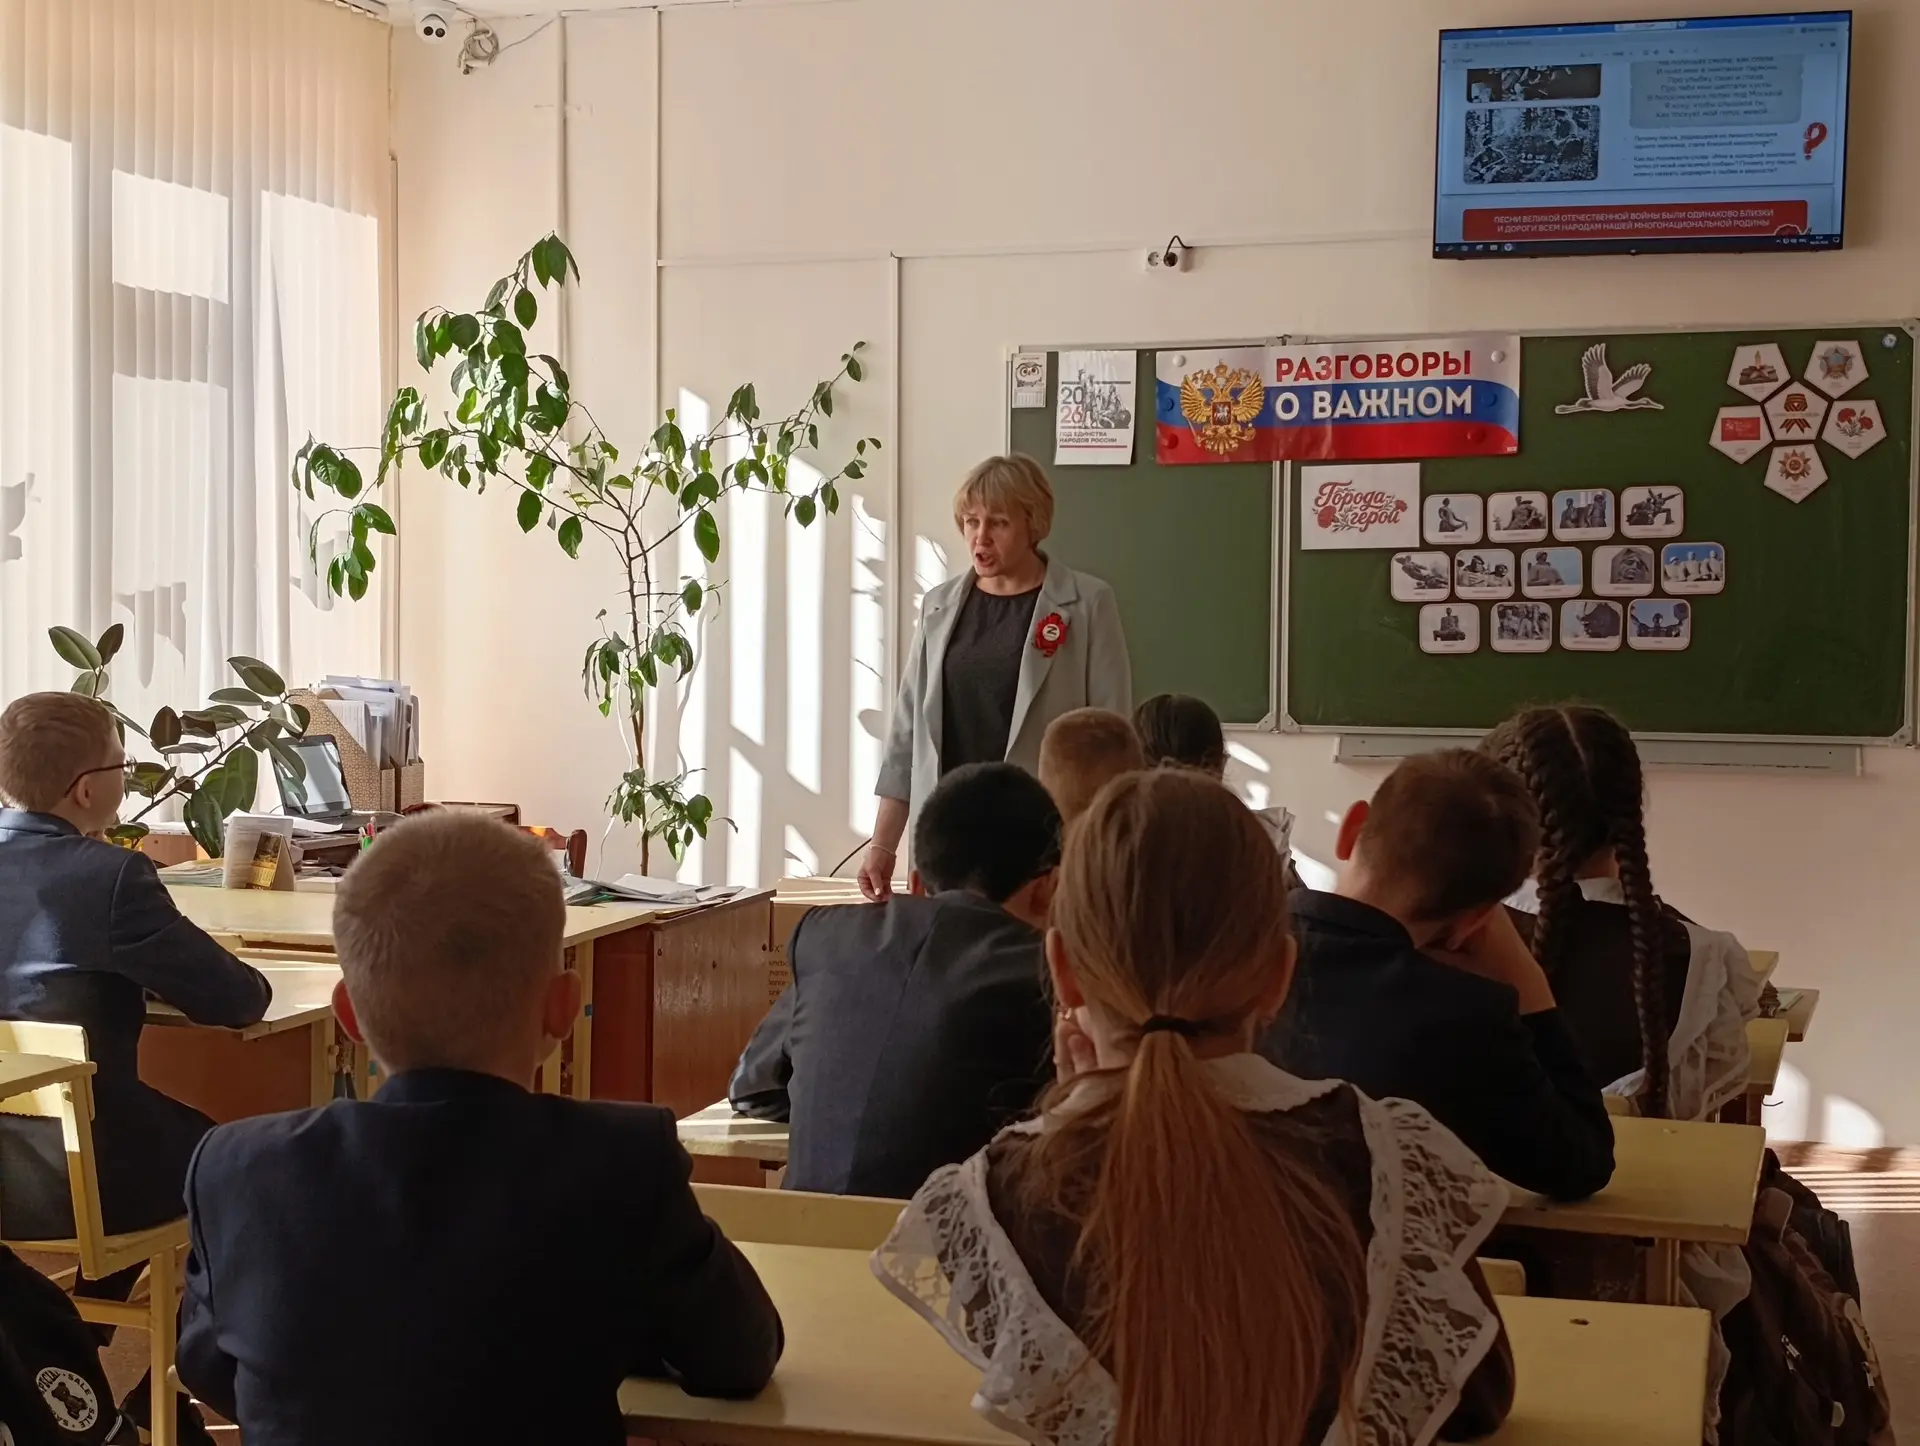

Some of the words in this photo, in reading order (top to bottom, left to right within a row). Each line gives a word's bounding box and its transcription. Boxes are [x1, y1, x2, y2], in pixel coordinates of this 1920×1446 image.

[1494, 216, 1521, 224] ПЕСНИ
[1523, 214, 1560, 223] ВЕЛИКОЙ
[1561, 212, 1629, 222] ОТЕЧЕСТВЕННОЙ
[1630, 212, 1660, 220] ВОЙНЫ
[1687, 210, 1739, 219] ОДИНАКОВО
[1740, 209, 1774, 217] БЛИЗКИ
[1505, 225, 1538, 234] ДОРОГИ
[1538, 224, 1560, 232] ВСЕМ
[1562, 224, 1602, 232] НАРОДАМ
[1603, 222, 1633, 230] НАШЕЙ
[1634, 219, 1732, 229] МНОГОНАЦИОНАЛЬНОЙ
[1733, 219, 1770, 227] РОДИНЫ
[1275, 349, 1472, 383] РАЗГОВОРЫ
[1061, 386, 1084, 405] 20
[1275, 391, 1299, 421] О
[1312, 385, 1473, 421] ВАЖНОМ
[1060, 406, 1084, 424] 26
[68, 1374, 92, 1395] SALE
[79, 1408, 95, 1428] SALE
